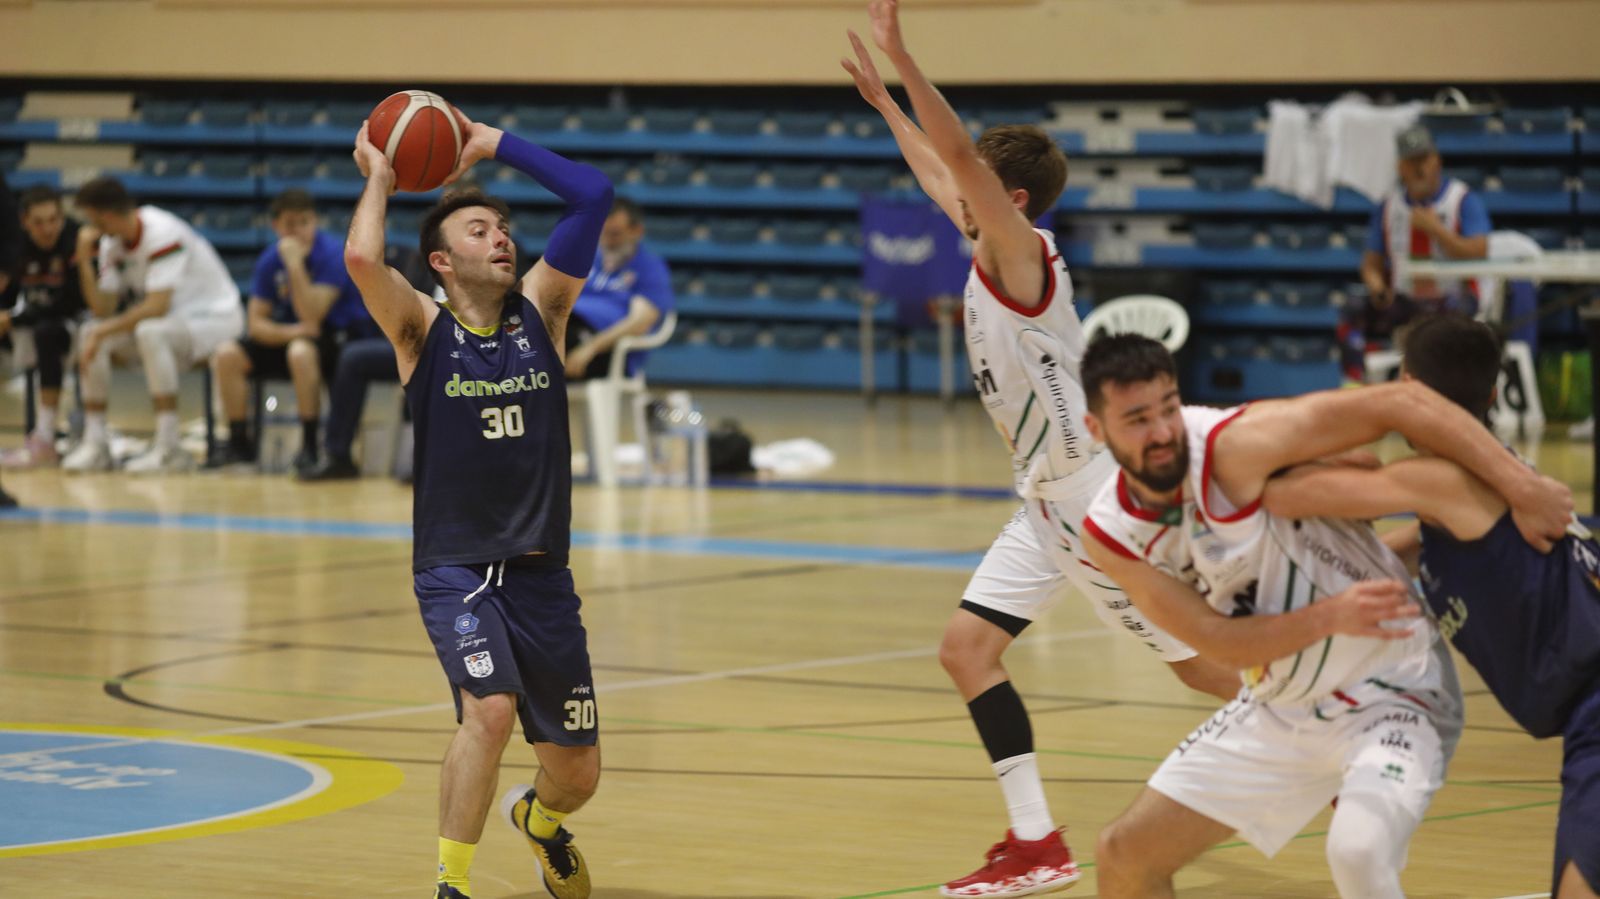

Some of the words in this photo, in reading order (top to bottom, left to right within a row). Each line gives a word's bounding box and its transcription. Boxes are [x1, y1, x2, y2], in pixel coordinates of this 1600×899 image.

[444, 367, 550, 398] damex.io
[480, 404, 525, 440] 30
[563, 699, 595, 731] 30
